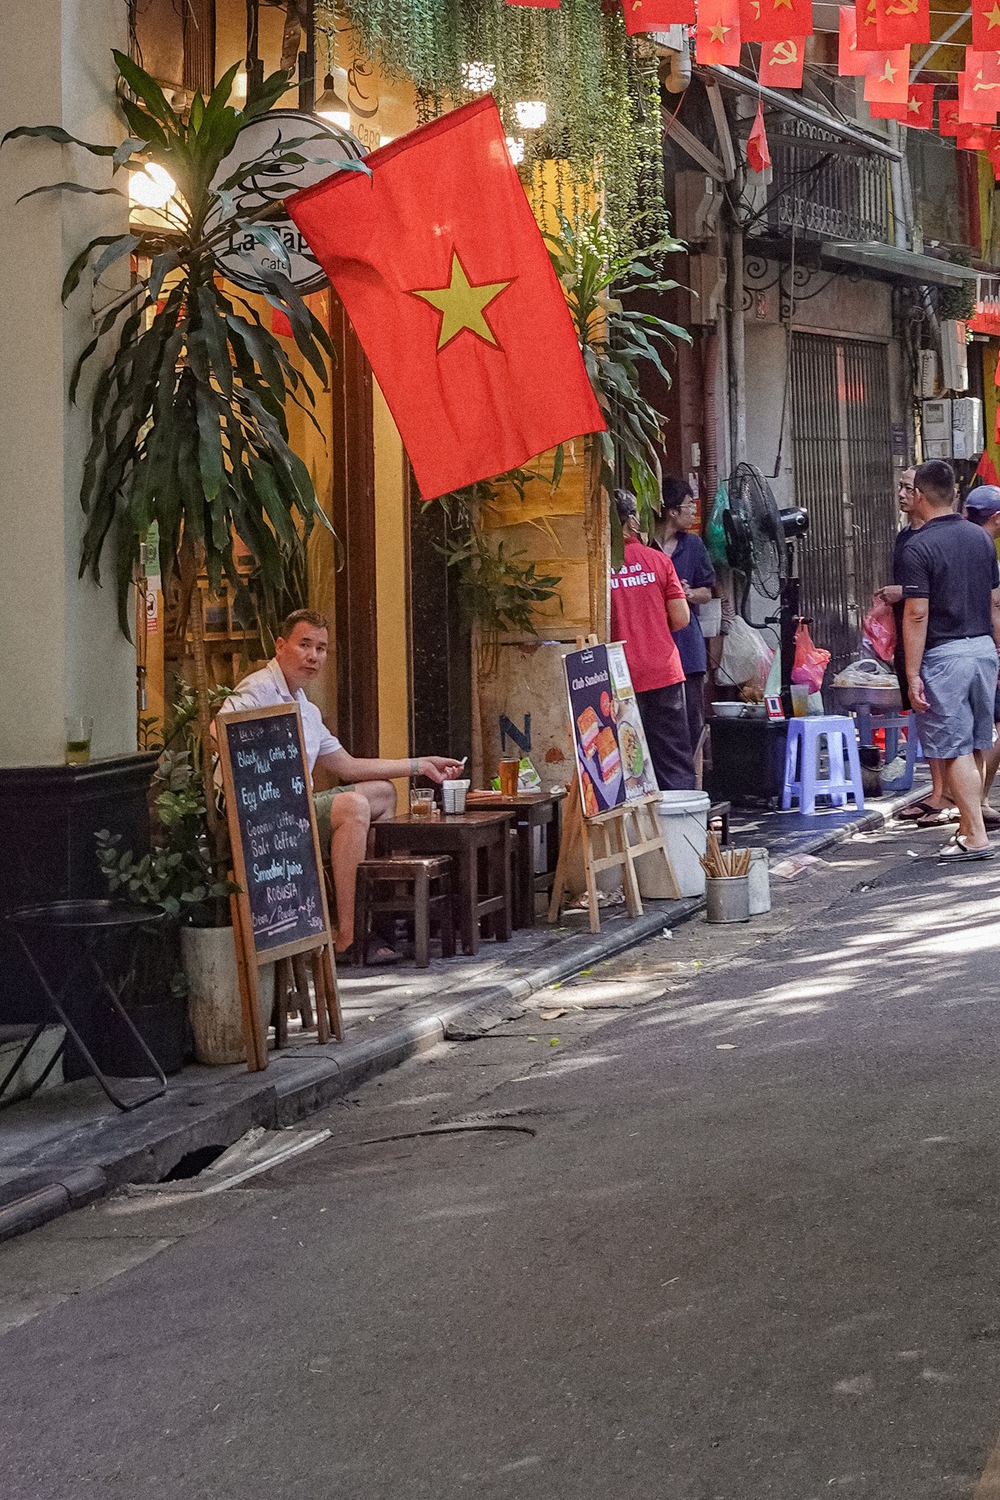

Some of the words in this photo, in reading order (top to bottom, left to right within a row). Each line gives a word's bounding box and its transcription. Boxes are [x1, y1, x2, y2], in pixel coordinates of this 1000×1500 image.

[621, 571, 656, 588] TRIỆU
[571, 677, 585, 692] Club
[585, 669, 609, 688] Sandwich
[236, 748, 256, 768] Black
[241, 787, 258, 812] Egg
[258, 781, 281, 802] Coffee
[251, 837, 270, 858] Salt
[266, 883, 298, 903] ROBUSTA
